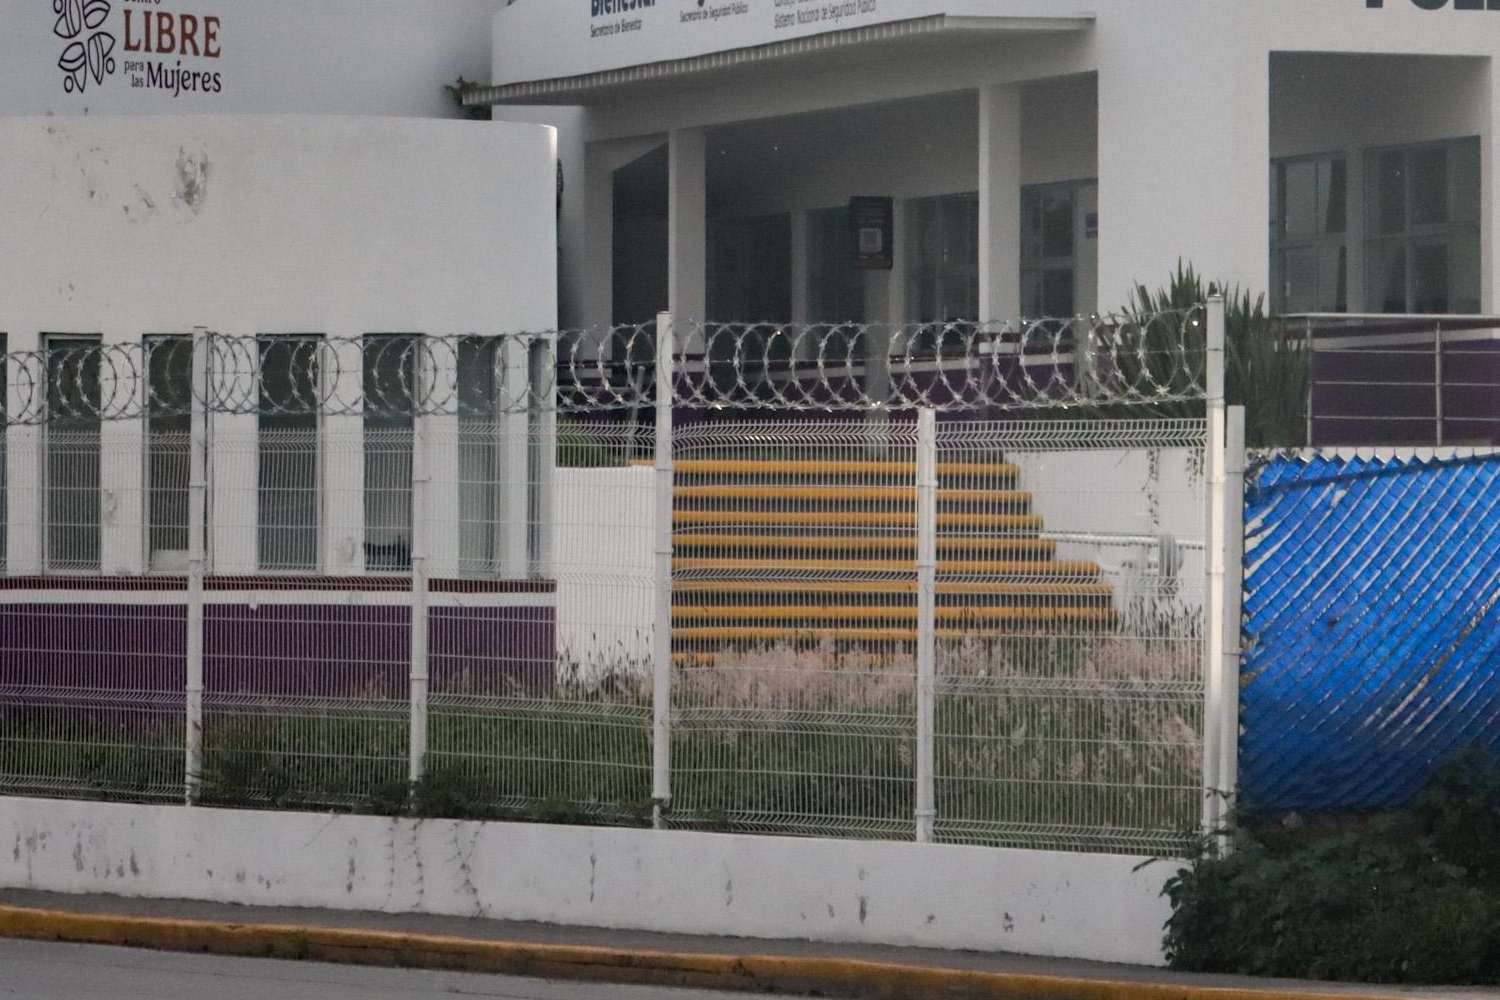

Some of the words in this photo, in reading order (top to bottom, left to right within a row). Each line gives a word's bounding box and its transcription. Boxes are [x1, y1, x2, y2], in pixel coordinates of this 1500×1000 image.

[124, 9, 220, 58] LIBRE
[124, 60, 144, 74] para
[131, 74, 144, 87] las
[146, 60, 221, 98] Mujeres
